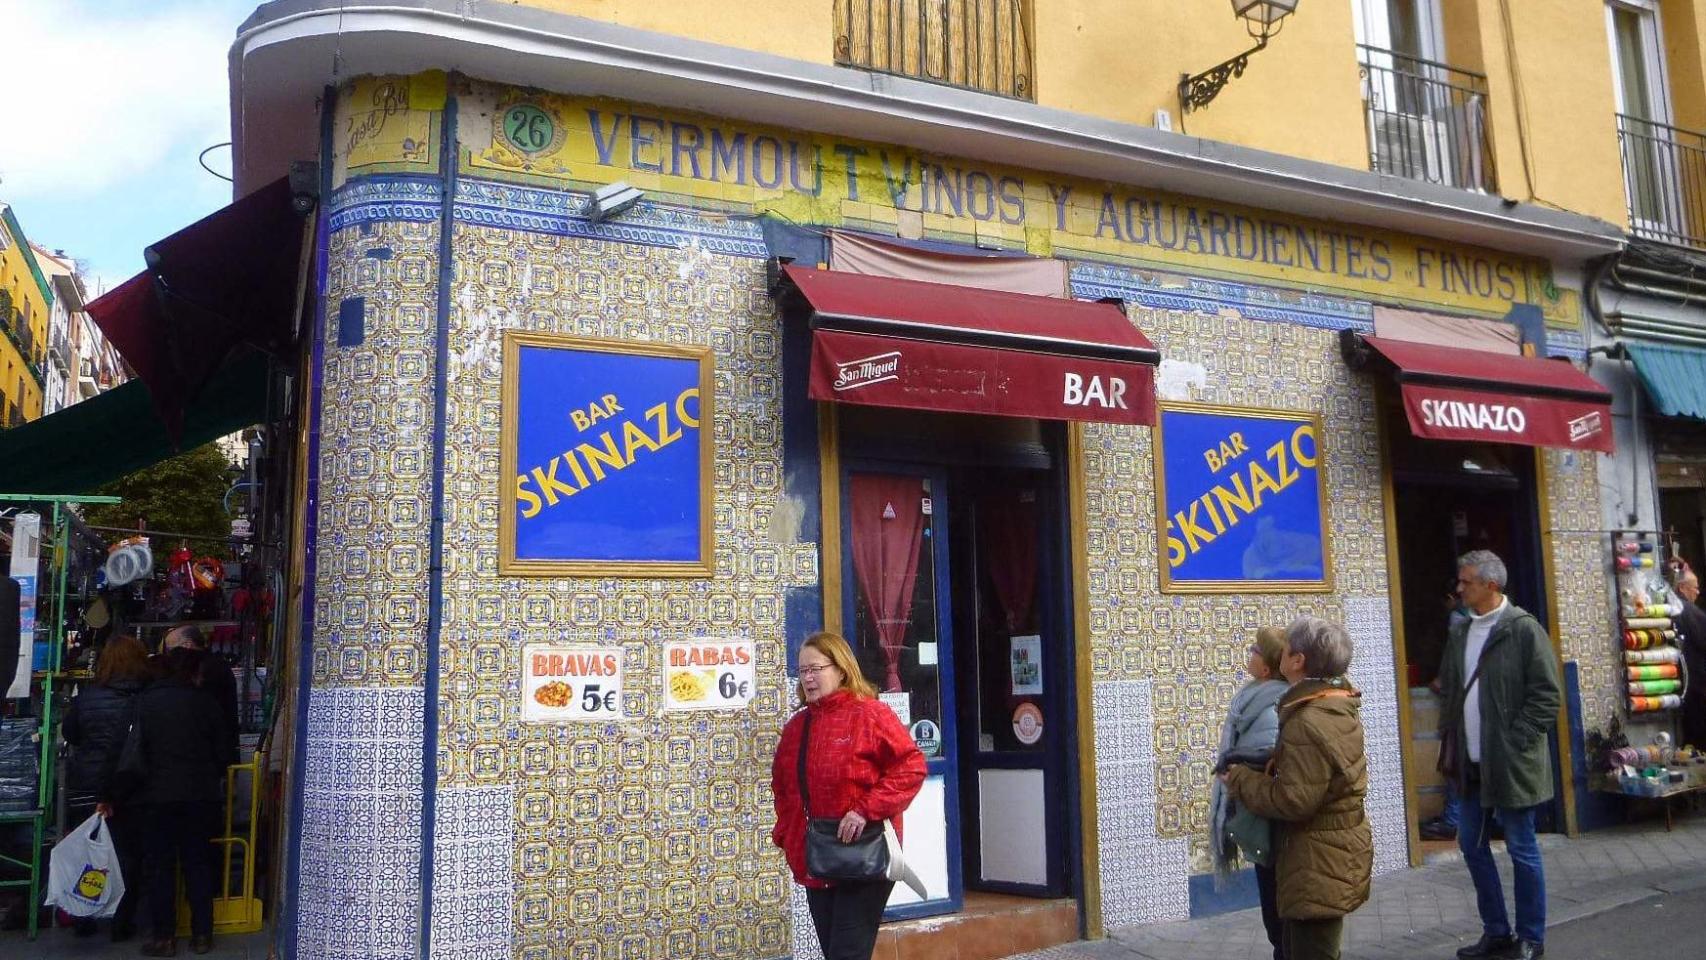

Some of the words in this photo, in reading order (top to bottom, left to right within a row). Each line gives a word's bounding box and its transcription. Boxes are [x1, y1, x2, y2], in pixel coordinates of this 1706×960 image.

[512, 111, 545, 148] 26
[586, 108, 868, 201] VERMOUT
[880, 150, 1025, 226] VINOS
[1048, 184, 1074, 231] Y
[1095, 192, 1393, 283] AGUARDIENTES
[1416, 247, 1516, 301] FINOS
[834, 367, 860, 387] San
[859, 358, 898, 379] Miguel
[1063, 372, 1129, 410] BAR
[569, 393, 624, 432] BAR
[1421, 399, 1526, 433] SKINAZO
[1203, 432, 1249, 473] BAR
[532, 653, 617, 677] BRAVAS
[669, 646, 750, 667] RABAS
[581, 684, 617, 712] 5€
[718, 672, 749, 699] 6€
